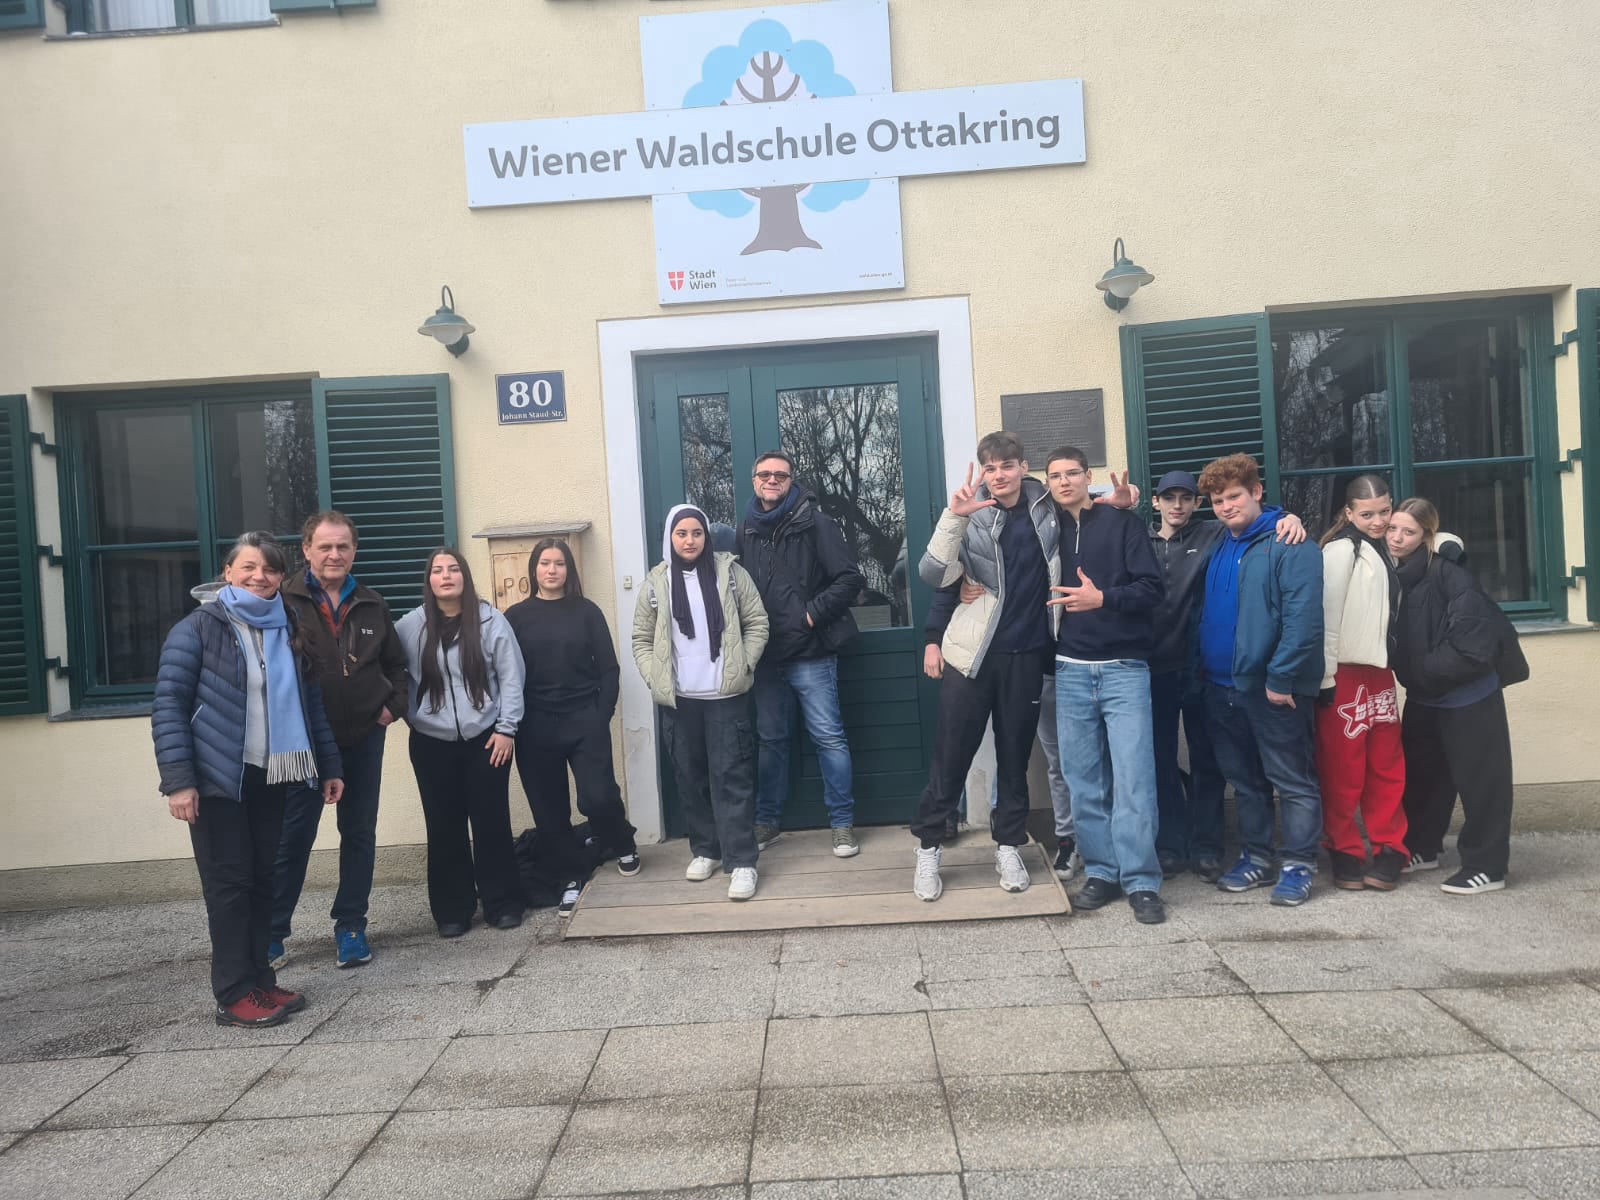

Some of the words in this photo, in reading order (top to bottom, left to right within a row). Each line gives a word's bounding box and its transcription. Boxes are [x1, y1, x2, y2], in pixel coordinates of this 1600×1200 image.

[488, 144, 627, 179] Wiener
[636, 122, 857, 169] Waldschule
[867, 109, 1060, 152] Ottakring
[689, 269, 716, 280] Stadt
[689, 280, 717, 290] Wien
[509, 379, 552, 408] 80
[502, 412, 528, 421] Johann
[504, 576, 529, 594] PO
